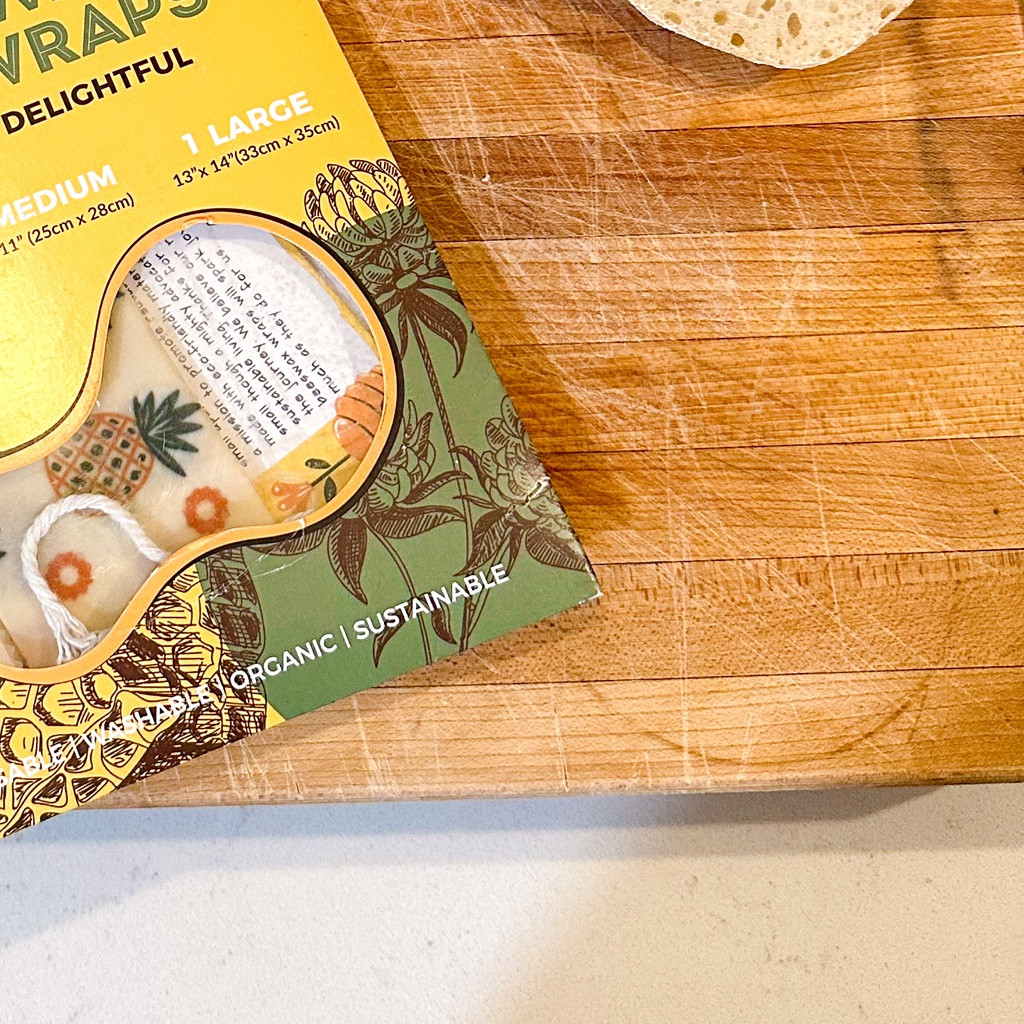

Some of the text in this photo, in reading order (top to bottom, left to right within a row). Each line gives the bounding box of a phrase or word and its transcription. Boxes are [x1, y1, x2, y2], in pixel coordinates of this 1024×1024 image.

[1, 47, 194, 134] DELIGHTFUL
[181, 91, 313, 155] 1 LARGE
[294, 115, 340, 142] 35cm)
[27, 217, 74, 247] (25cm
[88, 192, 135, 219] 28cm)
[154, 252, 175, 276] for
[193, 247, 226, 283] spark
[229, 268, 252, 291] for
[194, 273, 231, 317] believe
[224, 285, 244, 306] will
[252, 291, 268, 307] do
[178, 304, 215, 346] mighty
[231, 316, 249, 340] We
[244, 309, 279, 349] wraps
[267, 310, 293, 340] they
[154, 325, 202, 378] promote
[213, 347, 224, 356] a
[293, 342, 310, 357] as
[198, 380, 213, 397] to
[224, 358, 260, 402] though
[243, 357, 301, 425] sustainable
[280, 350, 328, 408] beeswax
[310, 359, 341, 395] much
[221, 381, 245, 411] with
[294, 392, 314, 415] the
[213, 397, 253, 445] mission
[258, 403, 288, 436] small
[252, 446, 263, 456] a
[83, 688, 213, 755] WASHABLE
[230, 633, 337, 690] ORGANIC
[353, 562, 510, 640] SUSTAINABLE
